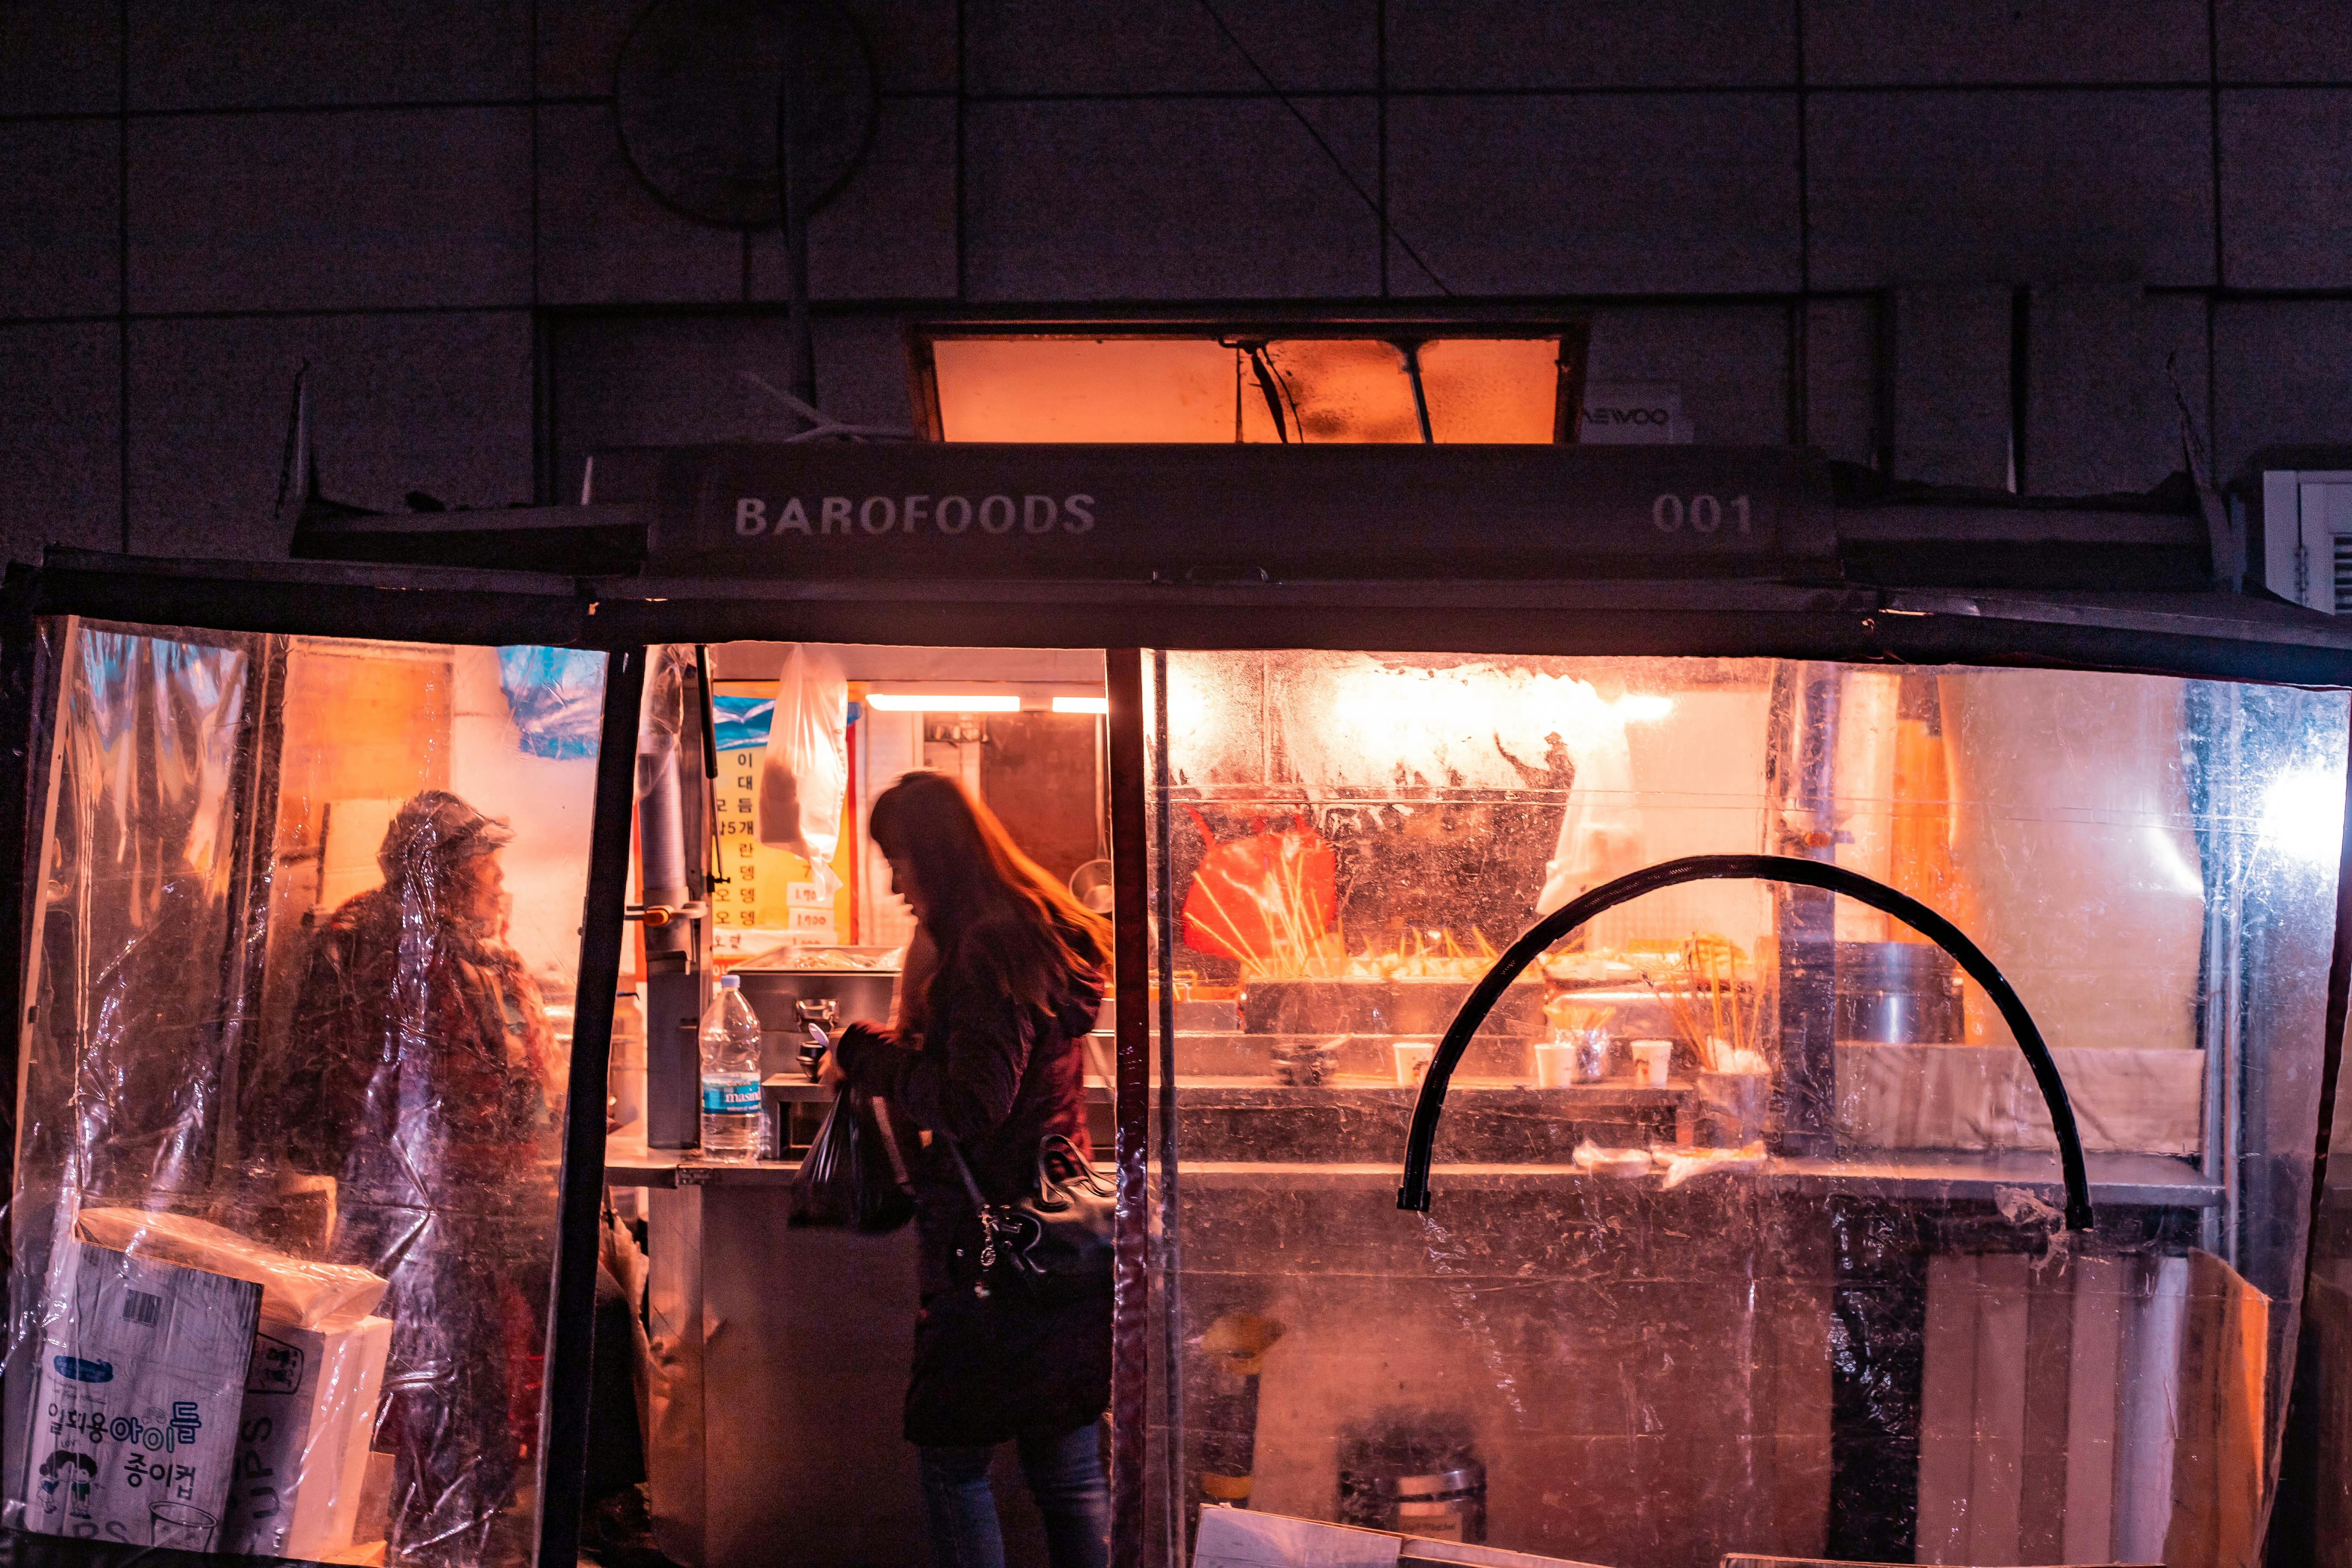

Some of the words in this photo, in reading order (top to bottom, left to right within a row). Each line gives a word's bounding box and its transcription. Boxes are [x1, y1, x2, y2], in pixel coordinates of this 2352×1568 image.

[735, 493, 1096, 536] BAROFOODS
[1653, 493, 1751, 533] 001
[110, 1401, 202, 1454] 아이들
[123, 1453, 196, 1500] 종이컵
[241, 1416, 280, 1553] UPS
